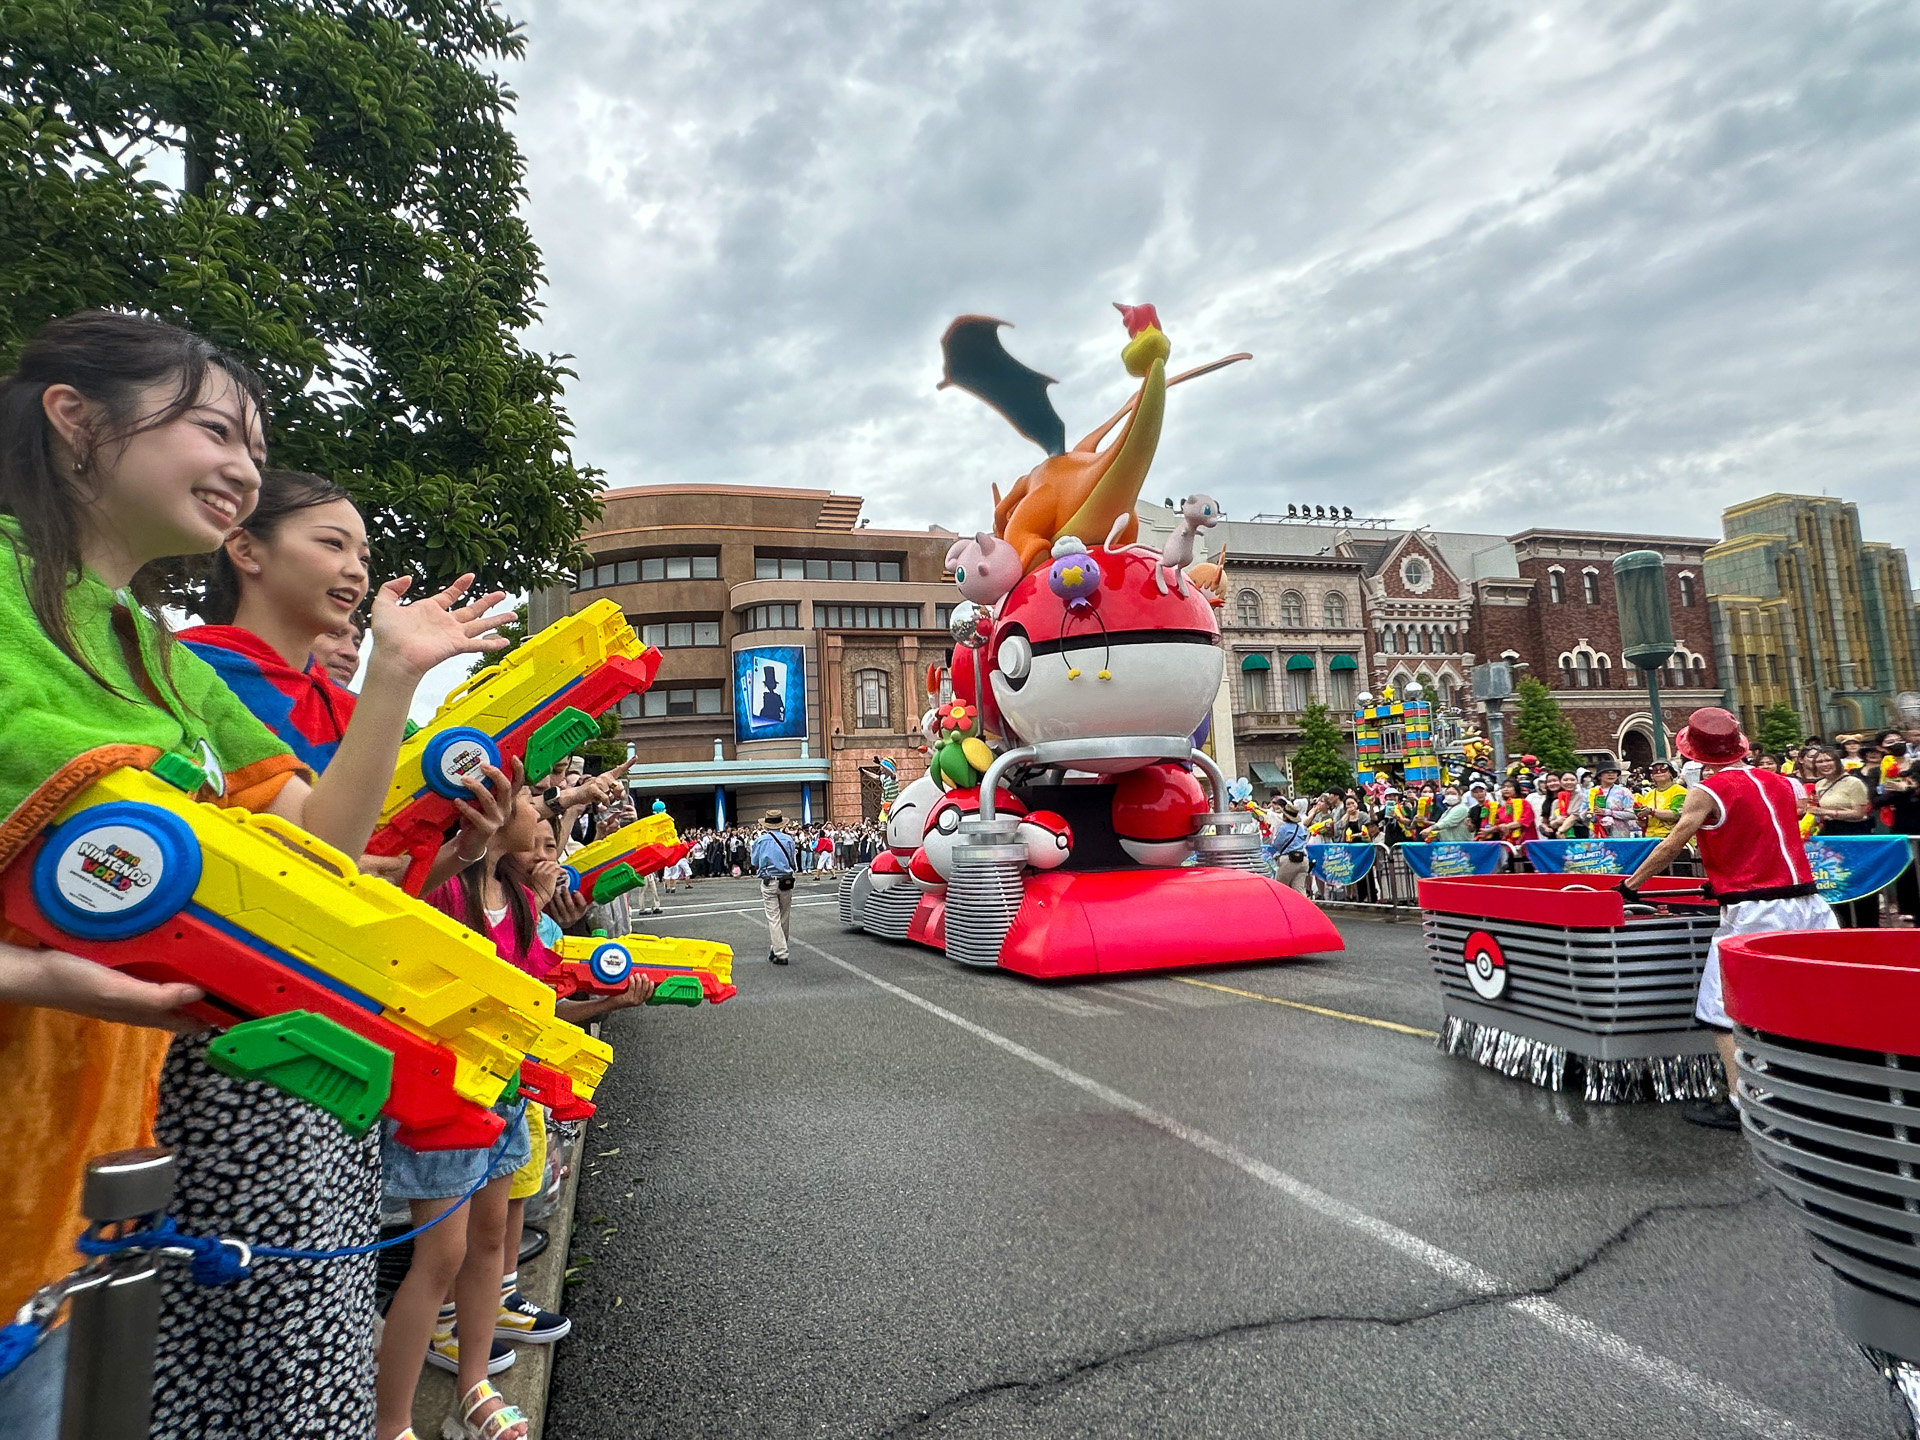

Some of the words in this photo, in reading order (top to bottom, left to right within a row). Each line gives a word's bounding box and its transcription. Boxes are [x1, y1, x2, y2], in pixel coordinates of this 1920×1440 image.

[446, 748, 482, 776] NINTENDO
[6, 758, 99, 839] NINTENDO
[77, 842, 152, 887] NINTENDO
[106, 844, 141, 867] SUPER
[81, 857, 132, 891] WORLD
